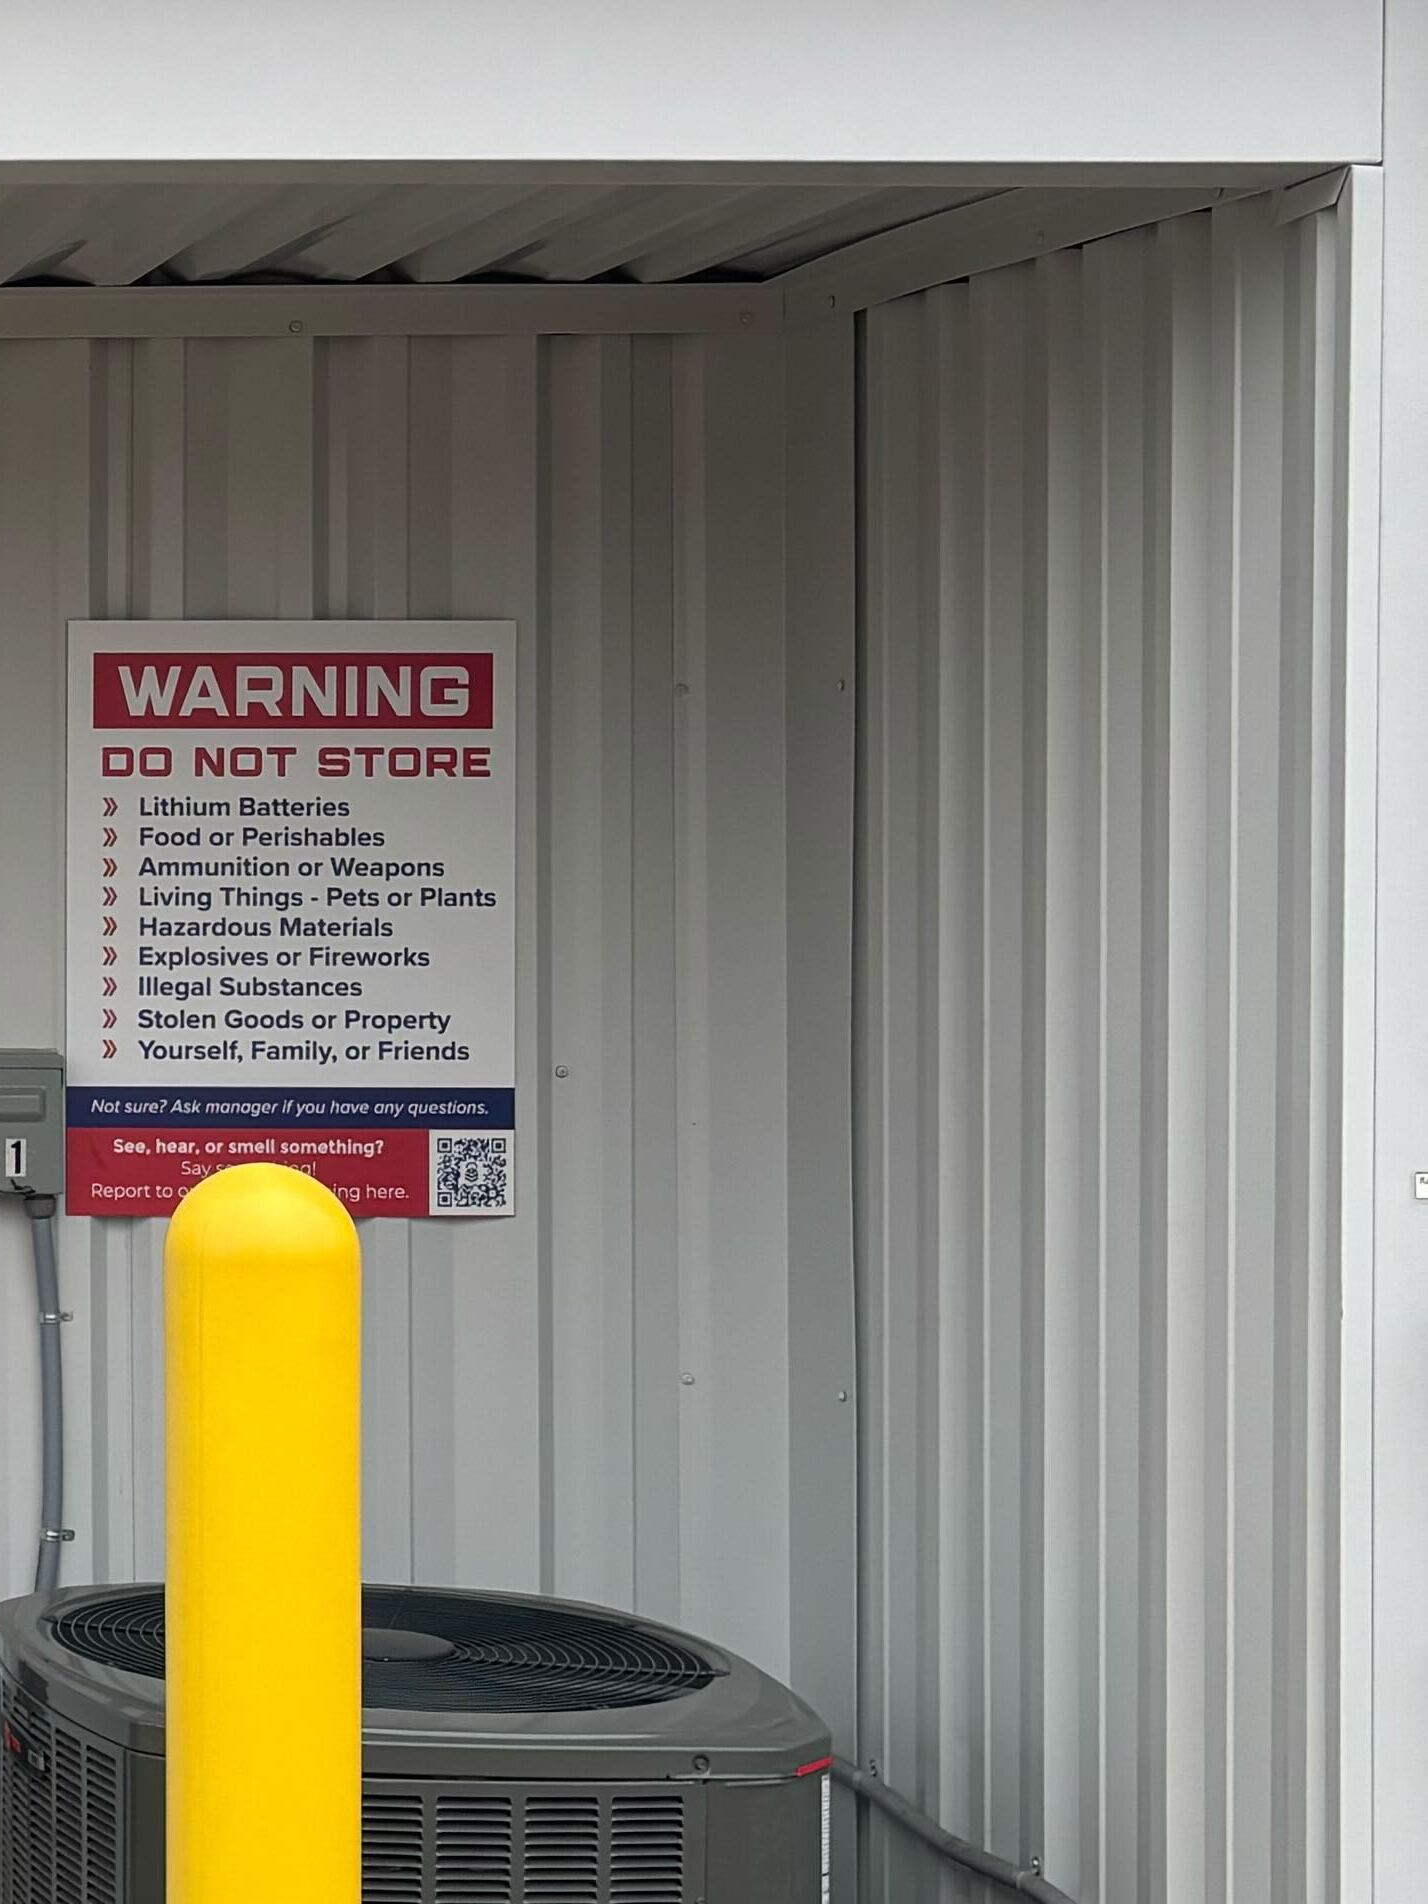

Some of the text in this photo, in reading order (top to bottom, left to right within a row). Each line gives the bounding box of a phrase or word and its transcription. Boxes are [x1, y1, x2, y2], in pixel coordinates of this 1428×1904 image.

[118, 666, 469, 716] WARNING
[102, 747, 490, 777] DO NOT STORE
[140, 797, 349, 816] Lithium Batteries
[140, 826, 384, 846] Food or Perishables
[139, 856, 444, 881] Ammunition or Weapons
[140, 886, 211, 911] Living
[220, 886, 303, 911] Things
[327, 887, 379, 906] Pets
[388, 892, 412, 906] or
[421, 888, 496, 907] Plants
[140, 916, 393, 936] Hazardous Materials
[140, 946, 429, 970] Explosives or Fireworks
[139, 977, 362, 1001] Illegal Substances
[138, 1009, 451, 1034] Stolen Goods or Property
[138, 1040, 469, 1065] Yourself, Family, or Friends
[91, 1099, 489, 1117] Not sure? Ask manager if you have any questions.
[11, 1140, 21, 1174] 1
[114, 1139, 383, 1157] See, hear, or smell something?
[181, 1161, 211, 1178] Say
[92, 1184, 149, 1200] Report
[156, 1185, 172, 1199] to
[366, 1184, 409, 1199] here.
